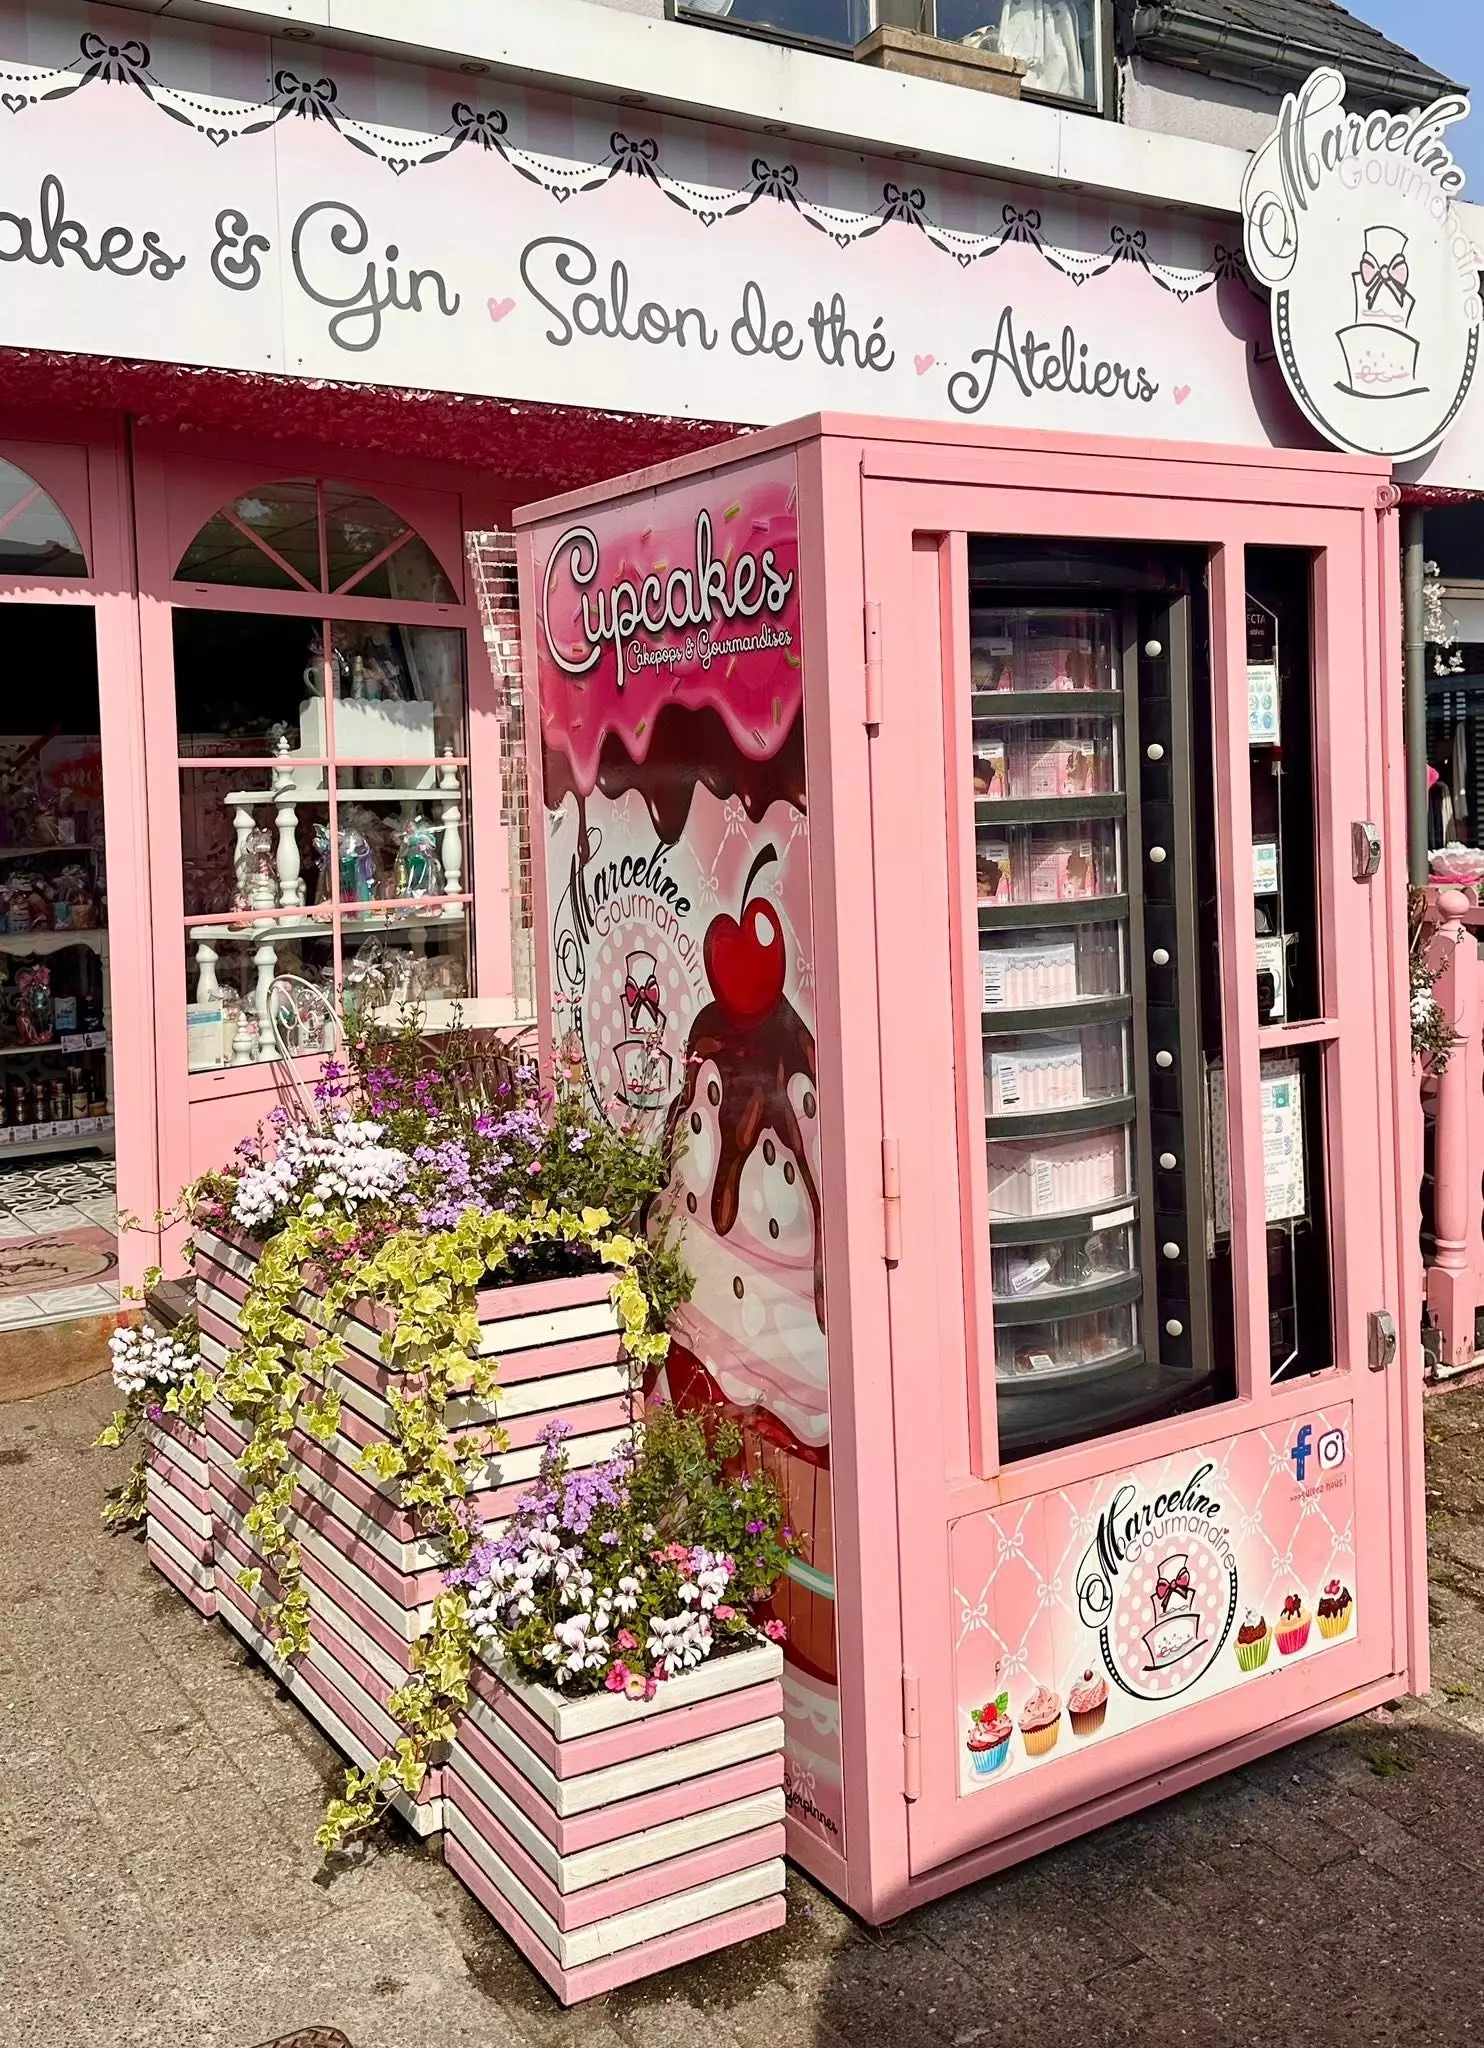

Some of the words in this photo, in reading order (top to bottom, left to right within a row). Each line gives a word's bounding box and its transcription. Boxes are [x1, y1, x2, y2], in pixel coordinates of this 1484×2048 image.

[1240, 73, 1466, 281] Marceline
[1338, 155, 1483, 321] Gourmandine
[210, 208, 271, 291] &
[291, 200, 460, 352] Gin
[520, 236, 718, 349] Salon
[730, 281, 804, 360] de
[808, 292, 895, 372] thé
[947, 305, 1160, 414] Ateliers
[542, 508, 794, 687] Cupcakes
[626, 639, 683, 675] Cakepops
[685, 637, 695, 660] &
[697, 623, 793, 670] Gourmandises
[554, 827, 691, 997] Marceline
[1076, 1463, 1220, 1628] Marceline
[1125, 1514, 1235, 1570] Gourmandine
